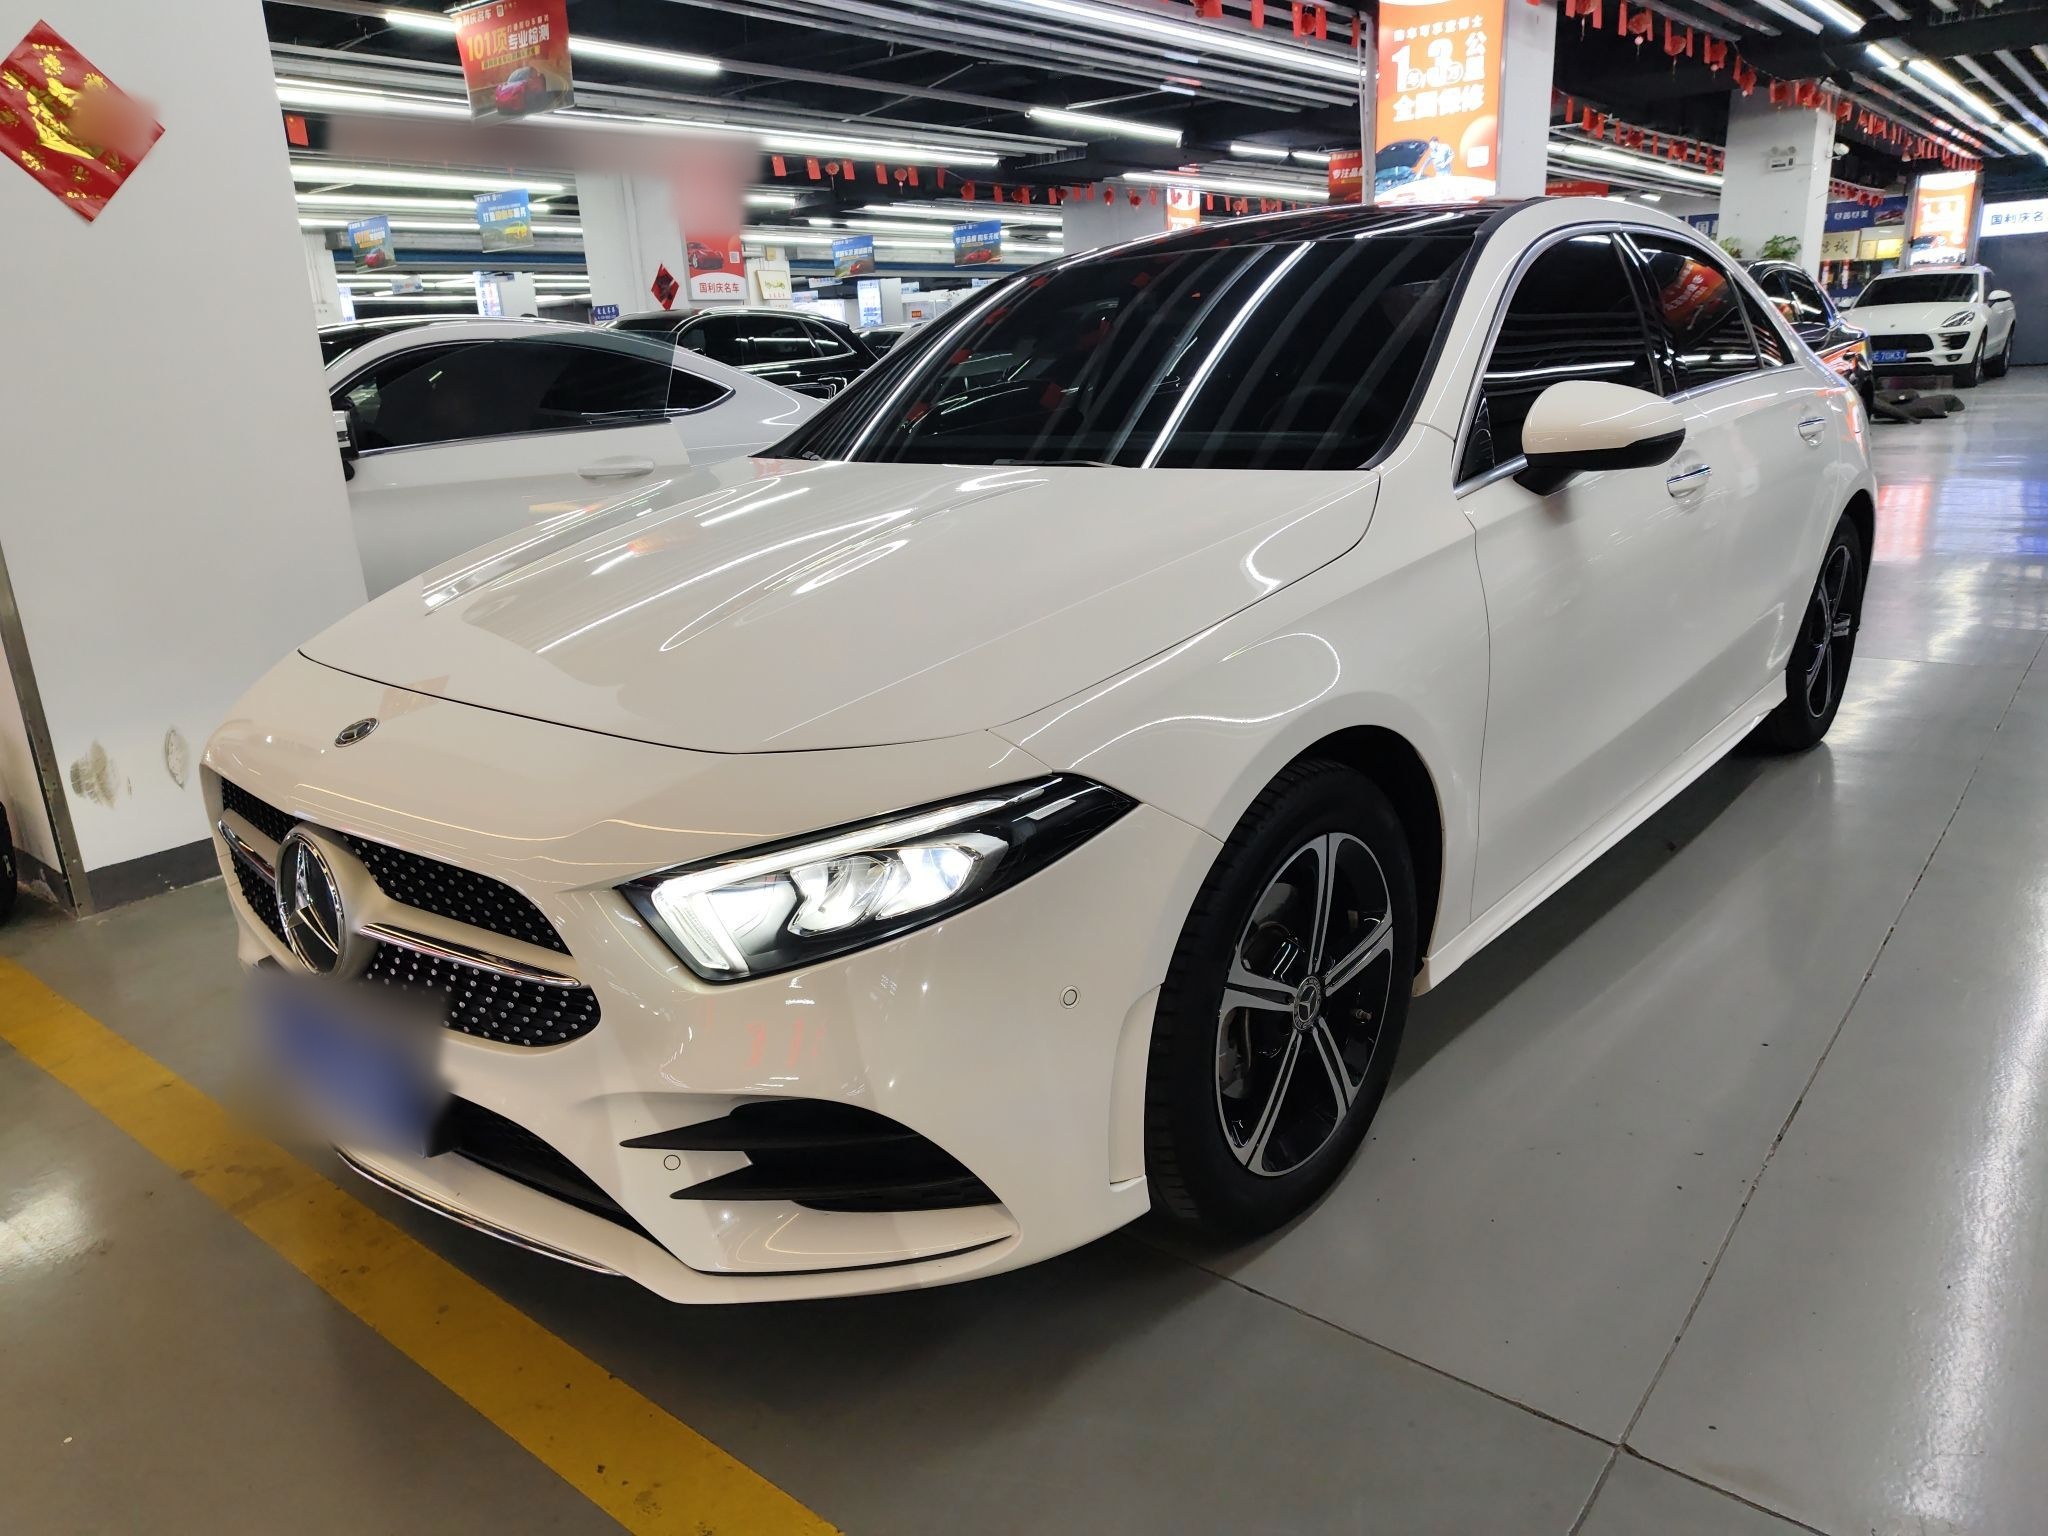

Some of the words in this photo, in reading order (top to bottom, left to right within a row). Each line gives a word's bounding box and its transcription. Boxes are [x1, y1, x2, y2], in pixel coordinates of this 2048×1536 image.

[1990, 211, 2048, 225] 国利庆名
[699, 282, 740, 293] 国利庆名车
